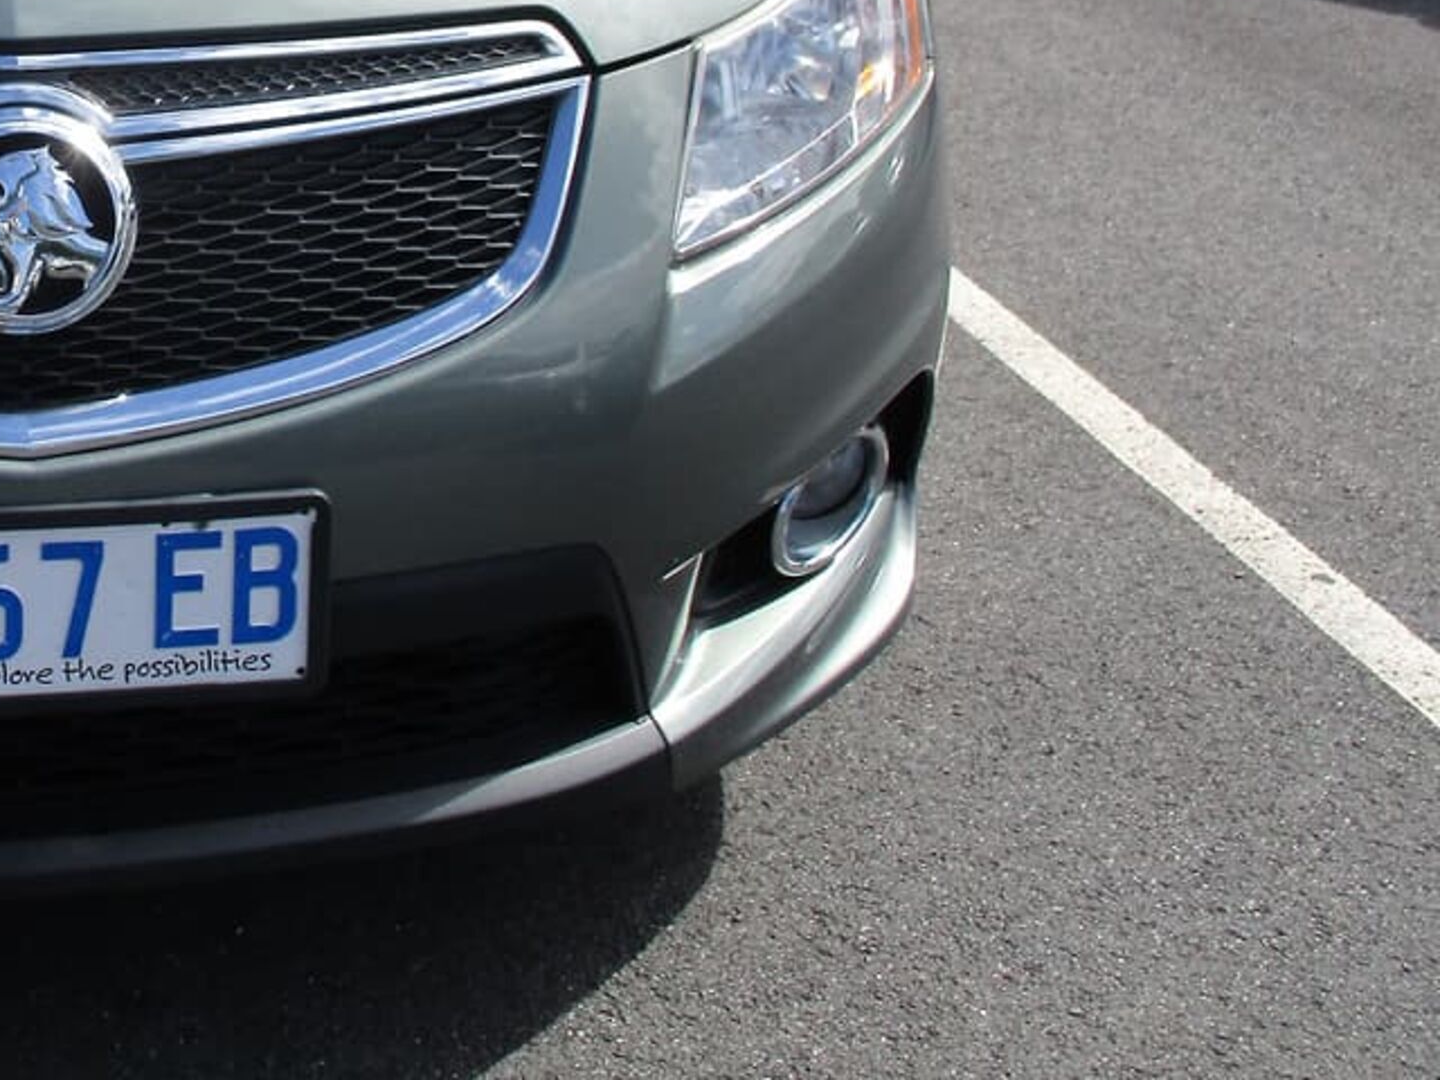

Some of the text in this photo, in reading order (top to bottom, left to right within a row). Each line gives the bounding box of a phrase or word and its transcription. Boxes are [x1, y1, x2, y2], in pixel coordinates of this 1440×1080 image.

[154, 527, 298, 649] EB
[63, 657, 116, 684] the
[123, 650, 273, 686] possibilities
